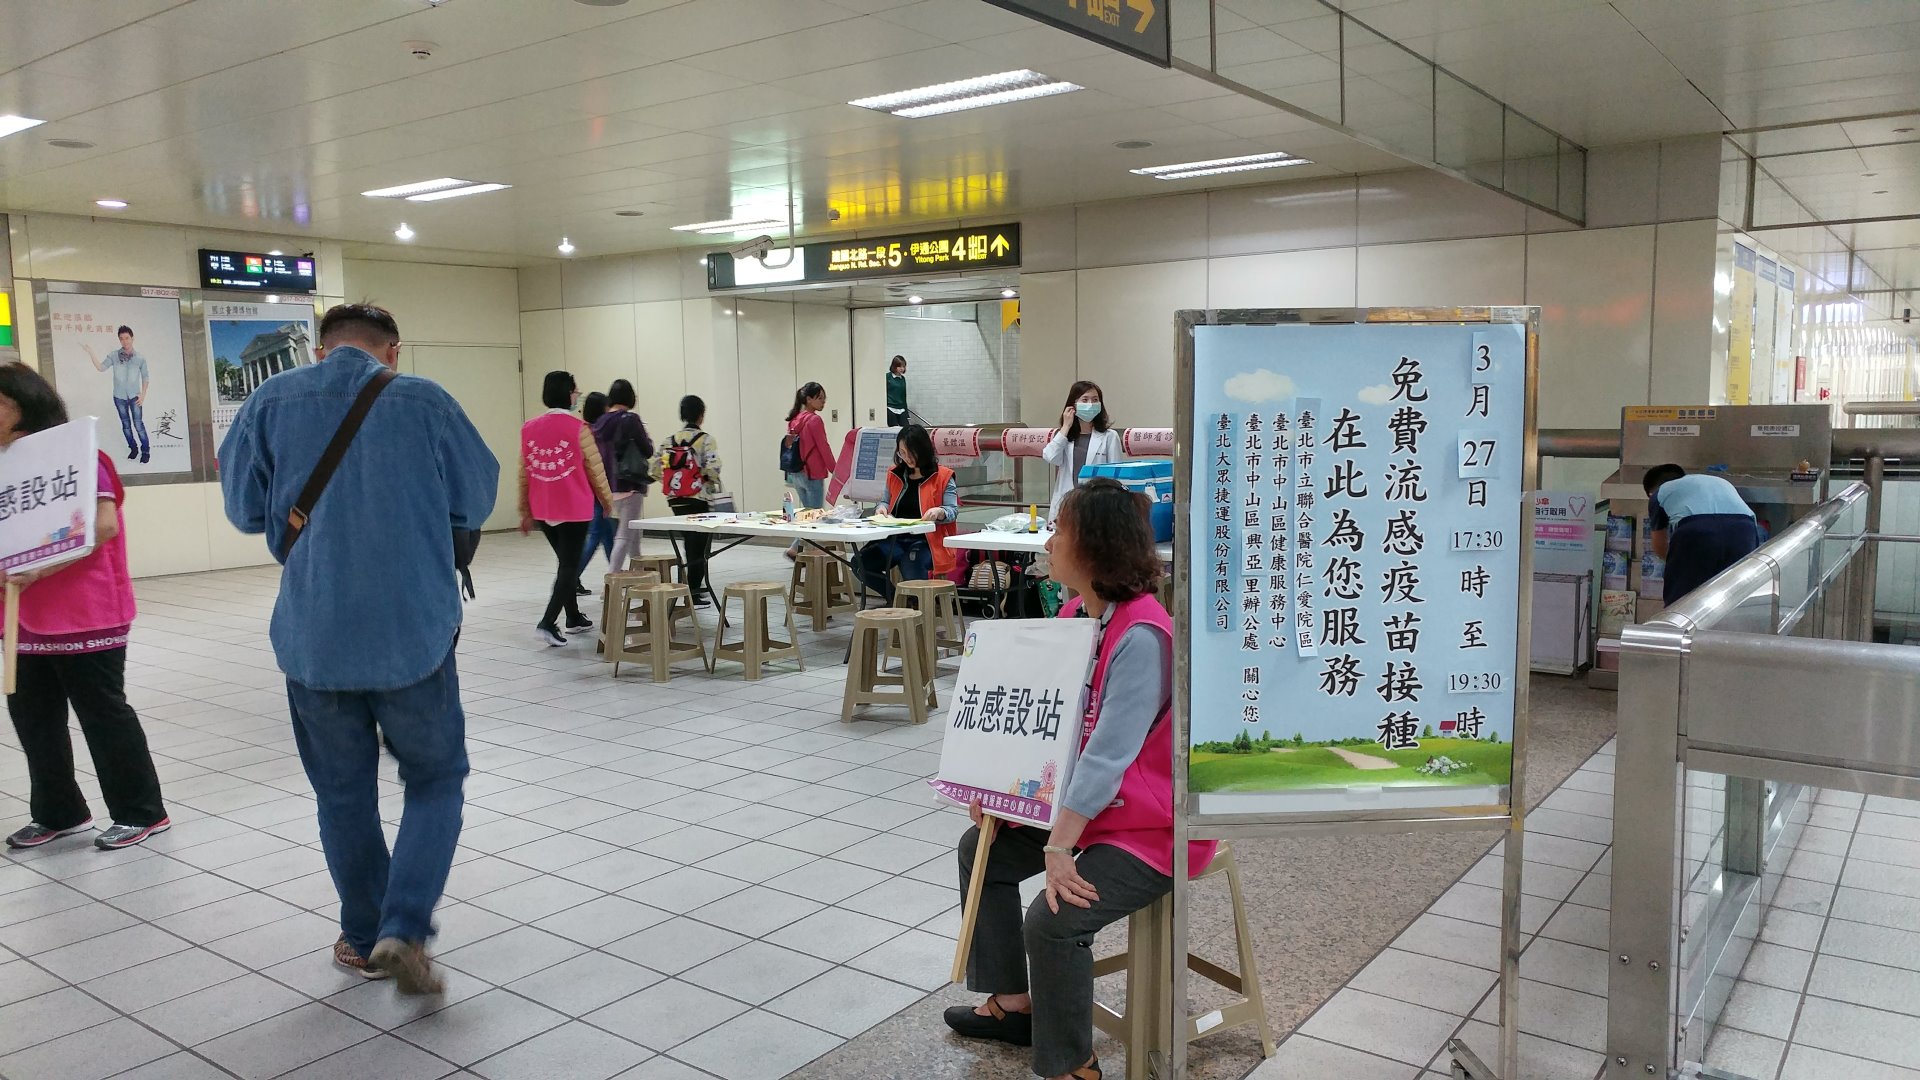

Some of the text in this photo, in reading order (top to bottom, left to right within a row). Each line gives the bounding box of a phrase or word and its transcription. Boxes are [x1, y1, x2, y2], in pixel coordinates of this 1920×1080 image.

[1104, 11, 1120, 27] EXIT
[888, 243, 902, 267] 5
[910, 235, 988, 261] 伊通公園 4 出口
[914, 254, 949, 264] Yitong Park
[1011, 433, 1045, 443] 資料登記
[1269, 412, 1290, 648] 臺北市中山區健康服務中心
[1296, 410, 1315, 649] 臺北市立聯合醫院仁愛院區
[1242, 413, 1263, 723] 臺北市中山區興亞里辦公處 關心您
[1319, 408, 1368, 697] 在此為您服務
[1376, 357, 1429, 750] 免費流感疫苗接種
[33, 642, 84, 651] FASHION
[953, 684, 1064, 741] 流感設站
